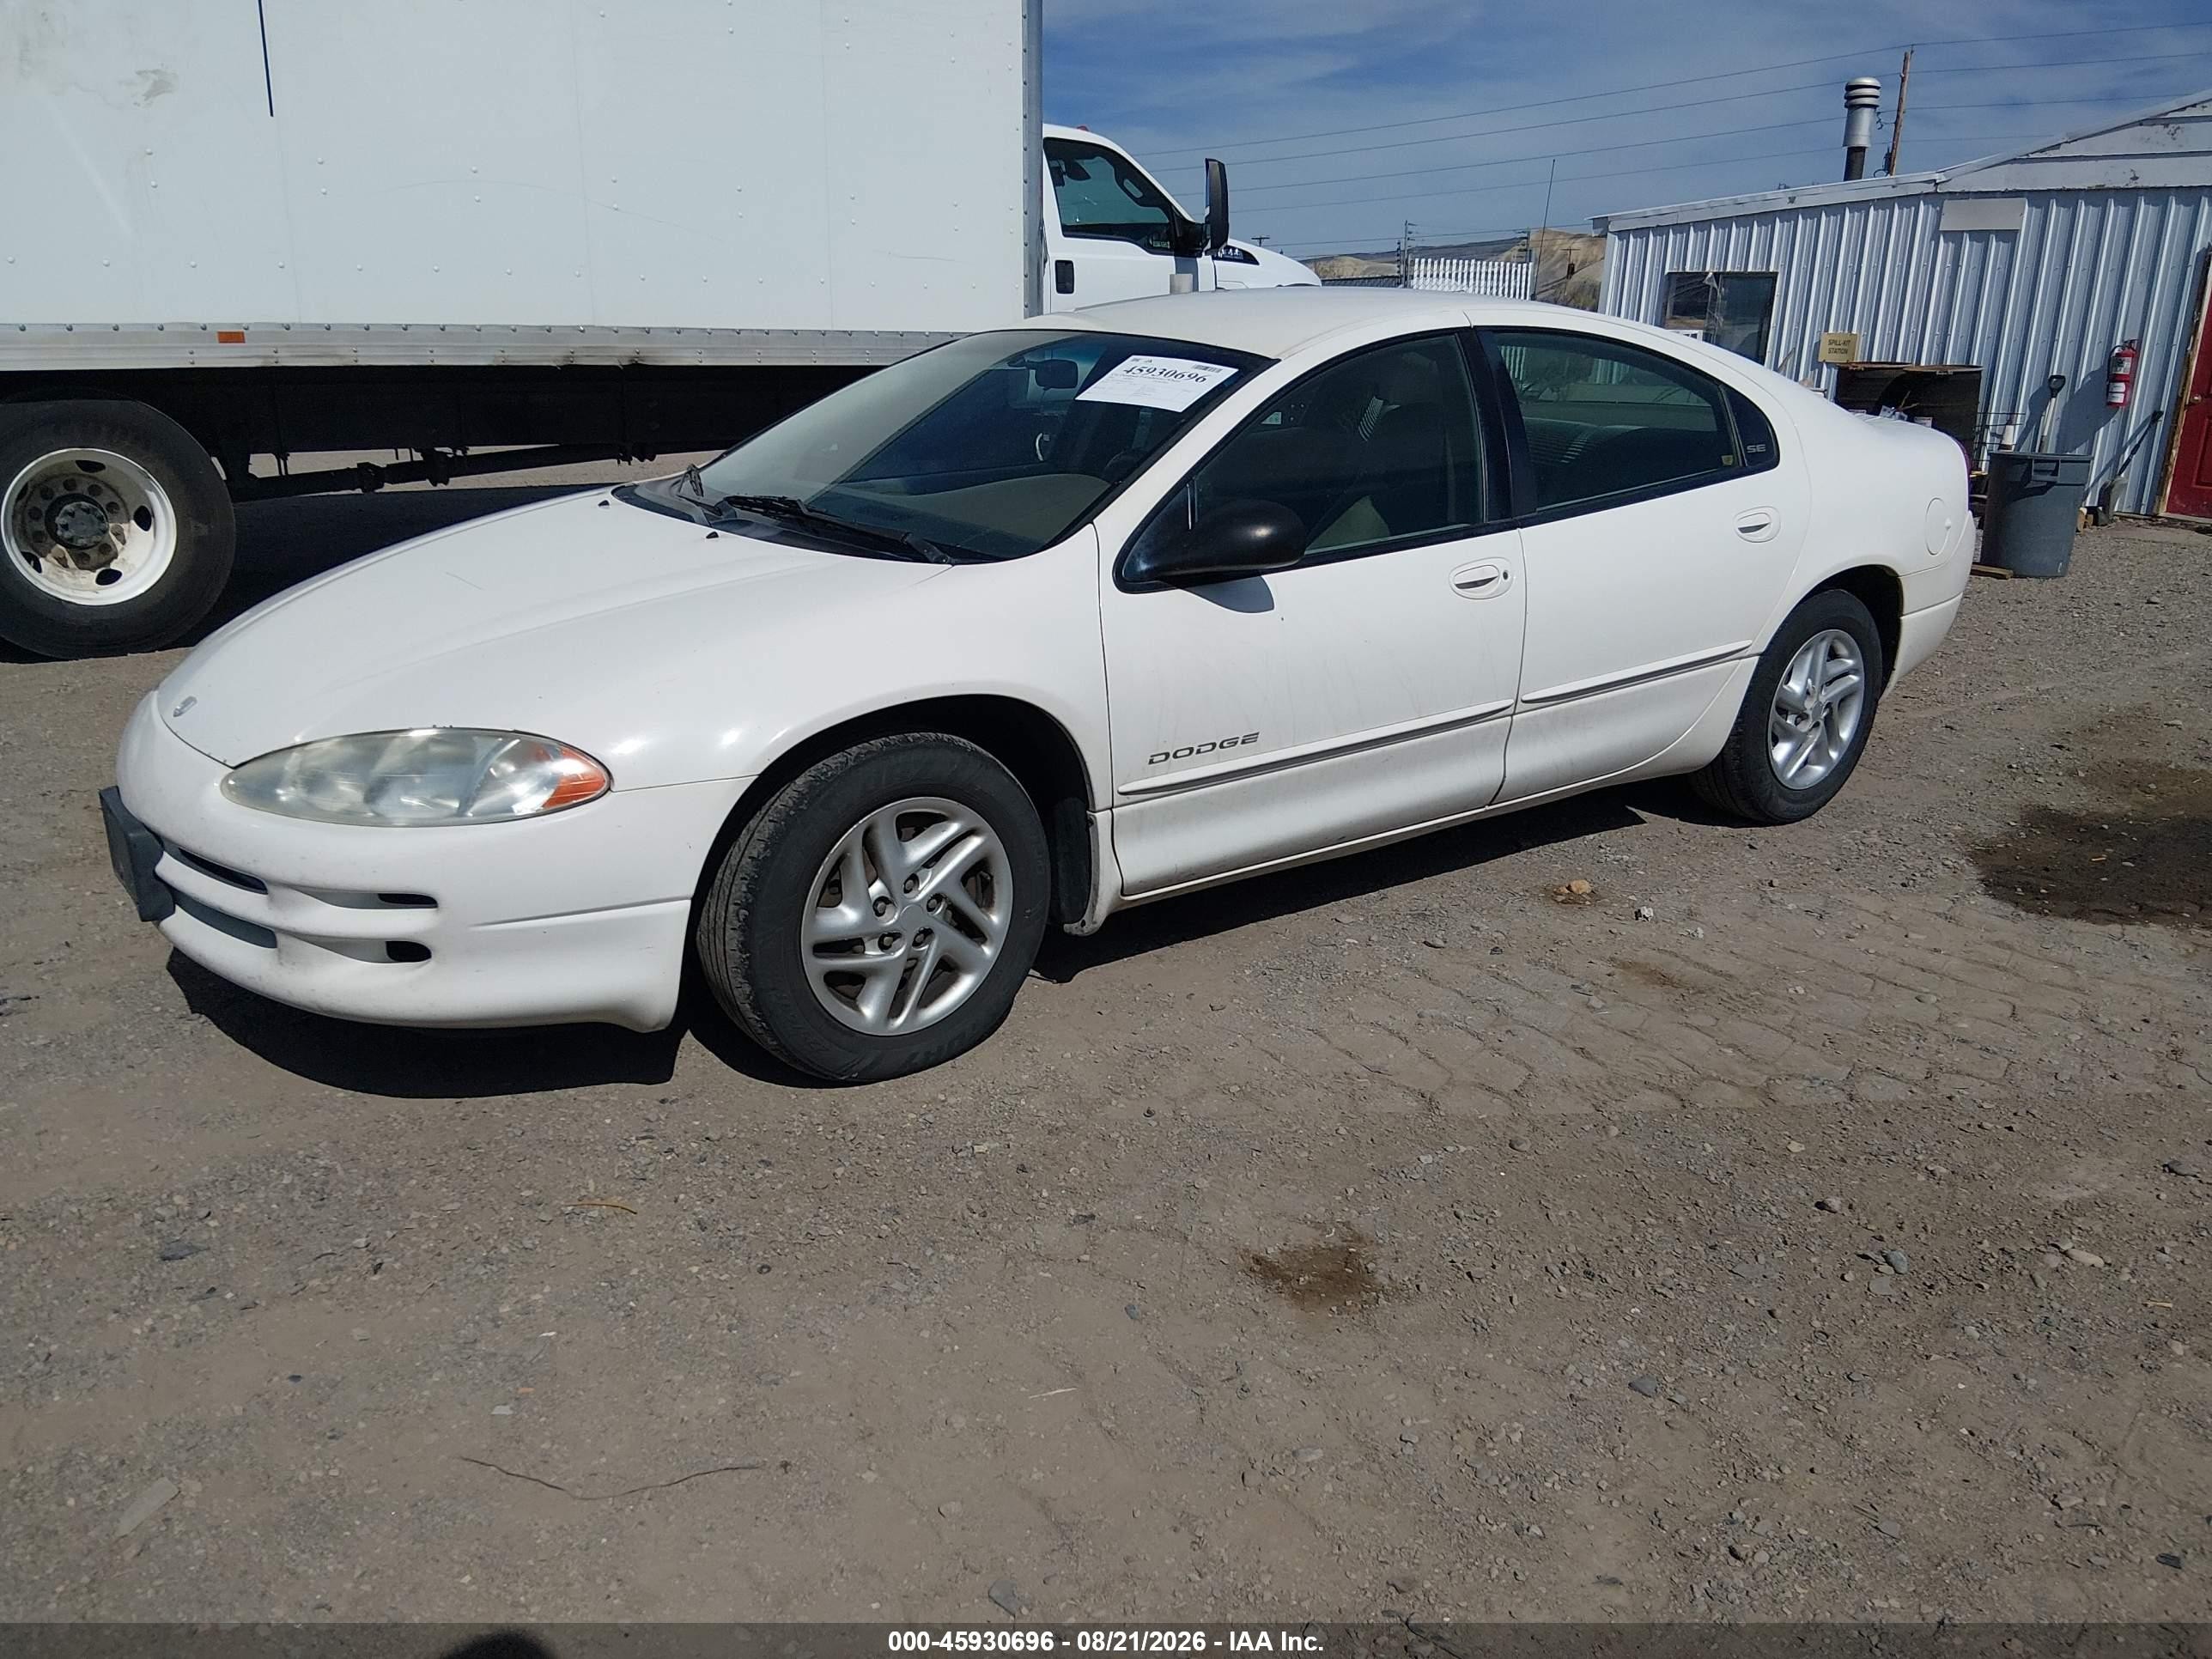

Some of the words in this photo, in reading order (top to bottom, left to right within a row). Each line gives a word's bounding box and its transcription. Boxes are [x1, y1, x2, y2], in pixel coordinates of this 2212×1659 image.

[1123, 365, 1207, 383] 45930696
[1747, 444, 1766, 453] SE
[1148, 732, 1260, 765] DODGE
